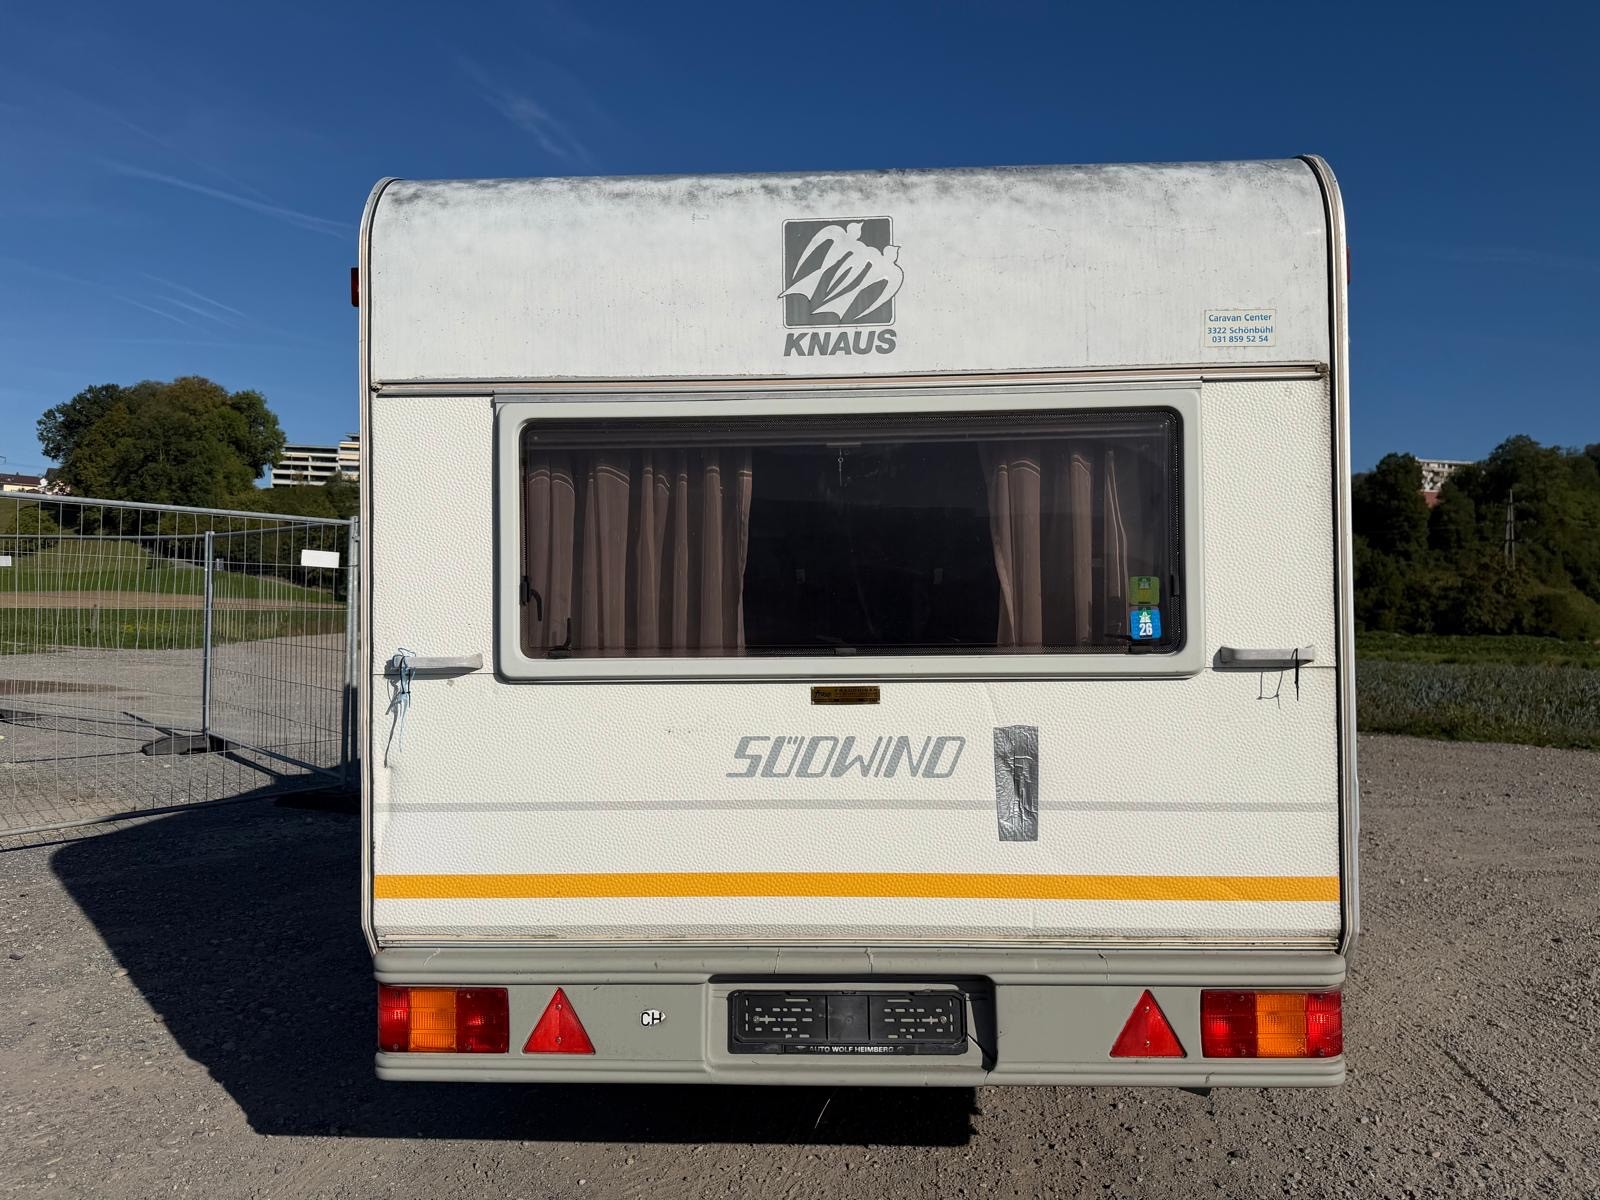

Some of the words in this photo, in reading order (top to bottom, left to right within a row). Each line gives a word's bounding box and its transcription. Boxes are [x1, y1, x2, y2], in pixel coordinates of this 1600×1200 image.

[1208, 314, 1242, 322] Caravan
[1244, 313, 1272, 321] Center
[1229, 325, 1273, 334] Schönbühl
[783, 328, 897, 357] KNAUS
[1139, 622, 1153, 636] 26
[725, 735, 967, 778] SÜDWIND
[640, 1011, 662, 1027] CH
[809, 1045, 830, 1053] AUTO
[831, 1045, 854, 1053] WOLF
[854, 1045, 894, 1053] HEIMBERG
